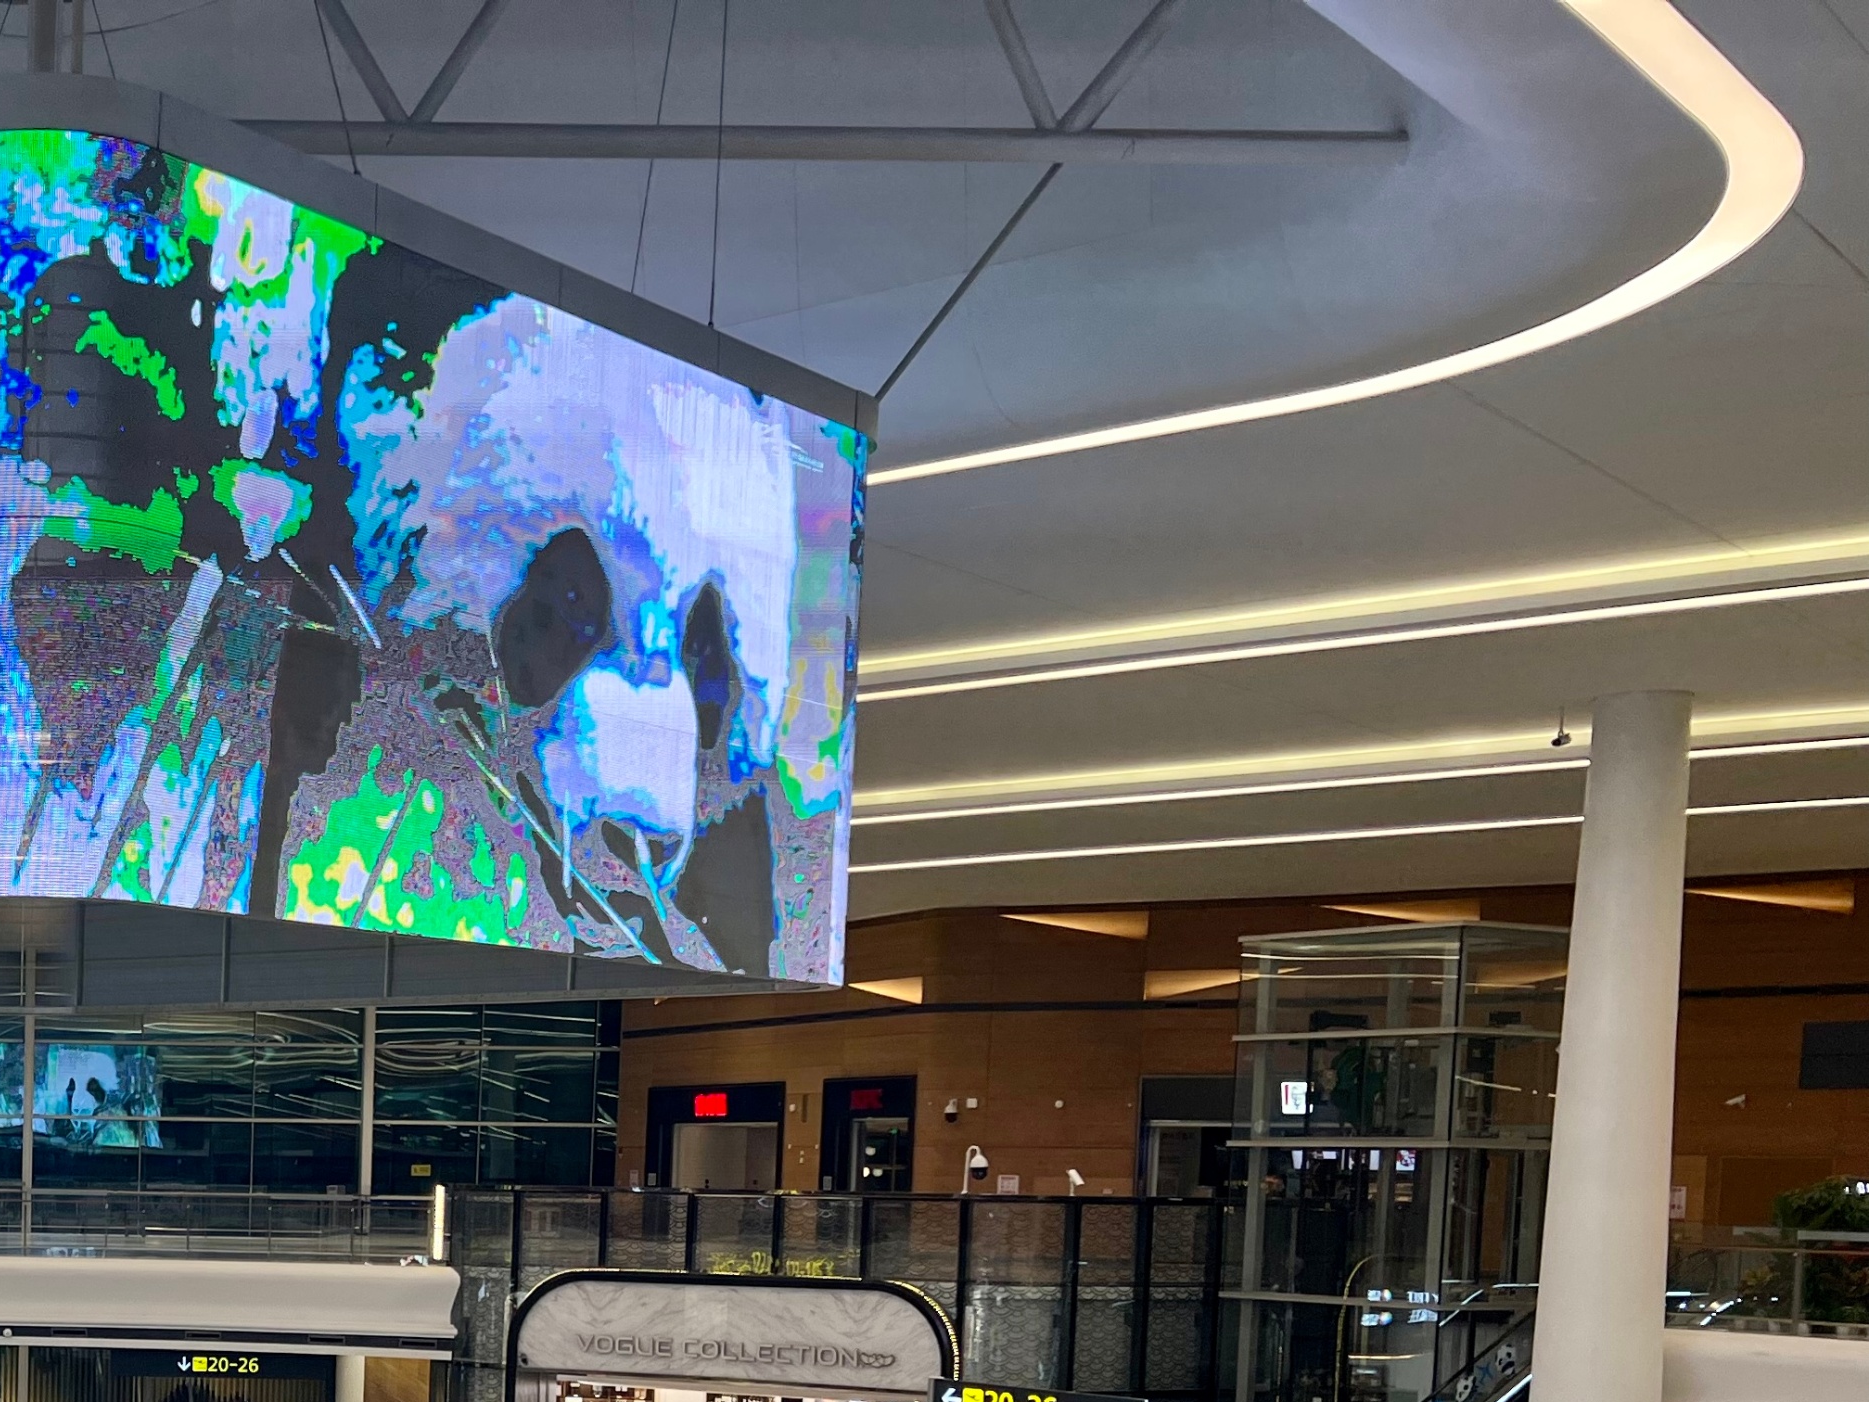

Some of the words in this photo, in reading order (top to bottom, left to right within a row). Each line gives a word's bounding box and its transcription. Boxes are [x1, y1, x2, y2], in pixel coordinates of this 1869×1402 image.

[577, 1334, 673, 1358] VOGUE
[682, 1339, 862, 1368] COLLECTION
[207, 1356, 260, 1374] 20-26
